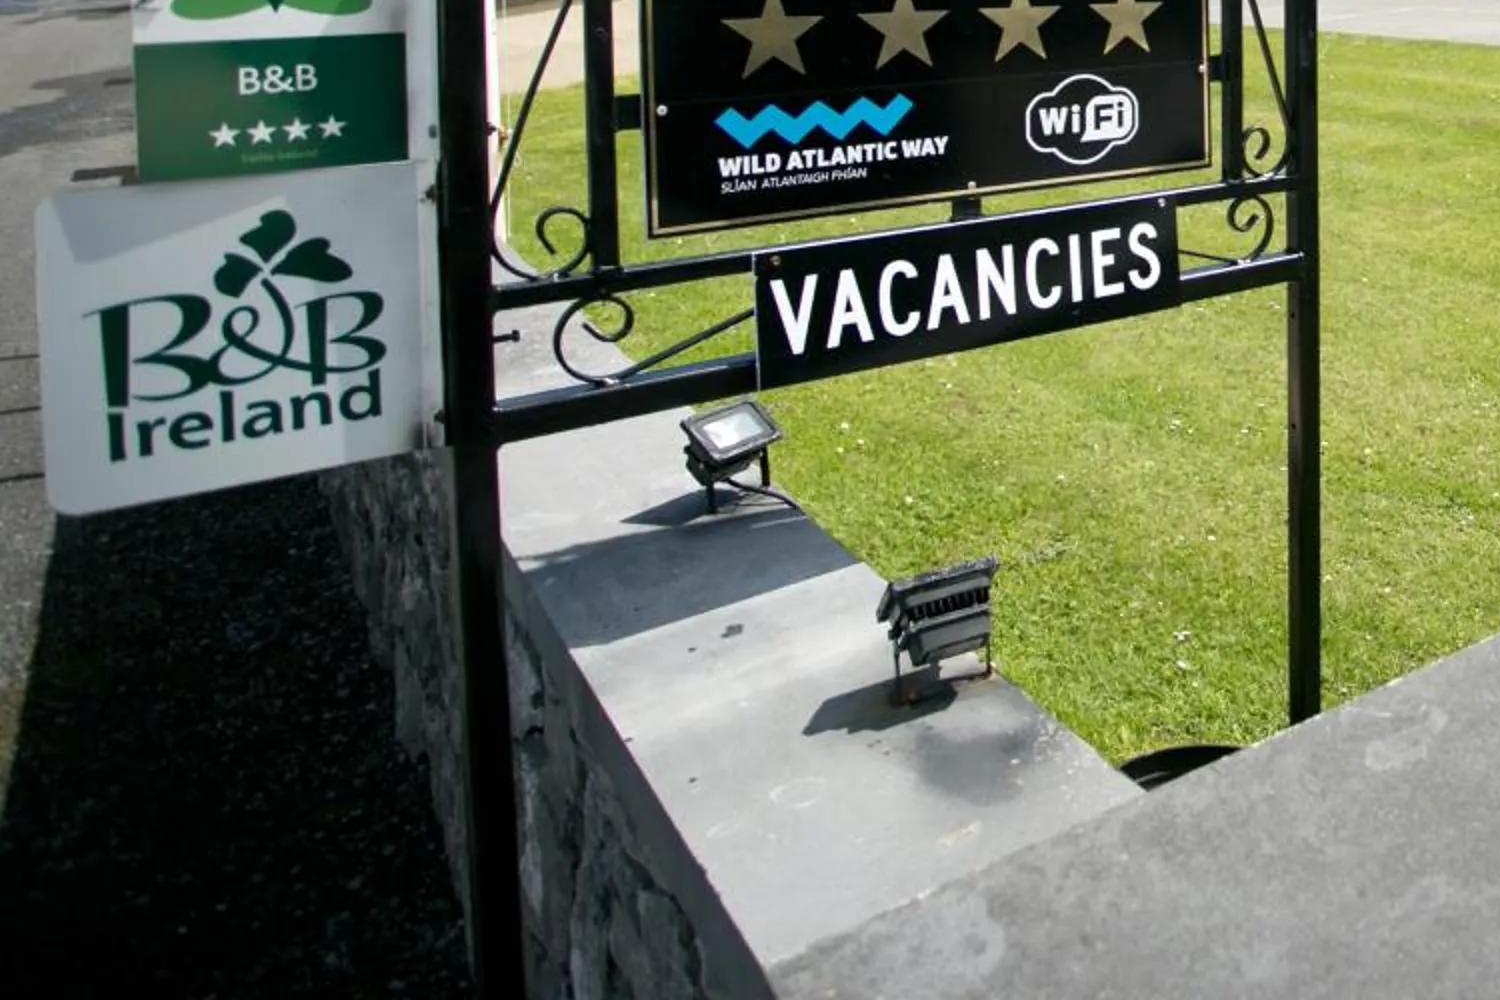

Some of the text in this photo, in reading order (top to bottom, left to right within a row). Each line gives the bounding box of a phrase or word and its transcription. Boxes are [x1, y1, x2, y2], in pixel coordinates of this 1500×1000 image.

[238, 64, 318, 95] B&B
[718, 136, 949, 177] WILD ATLANTIC WAY
[770, 221, 1162, 356] VACANCIES
[82, 291, 388, 408] B&B
[107, 368, 383, 463] Ireland
